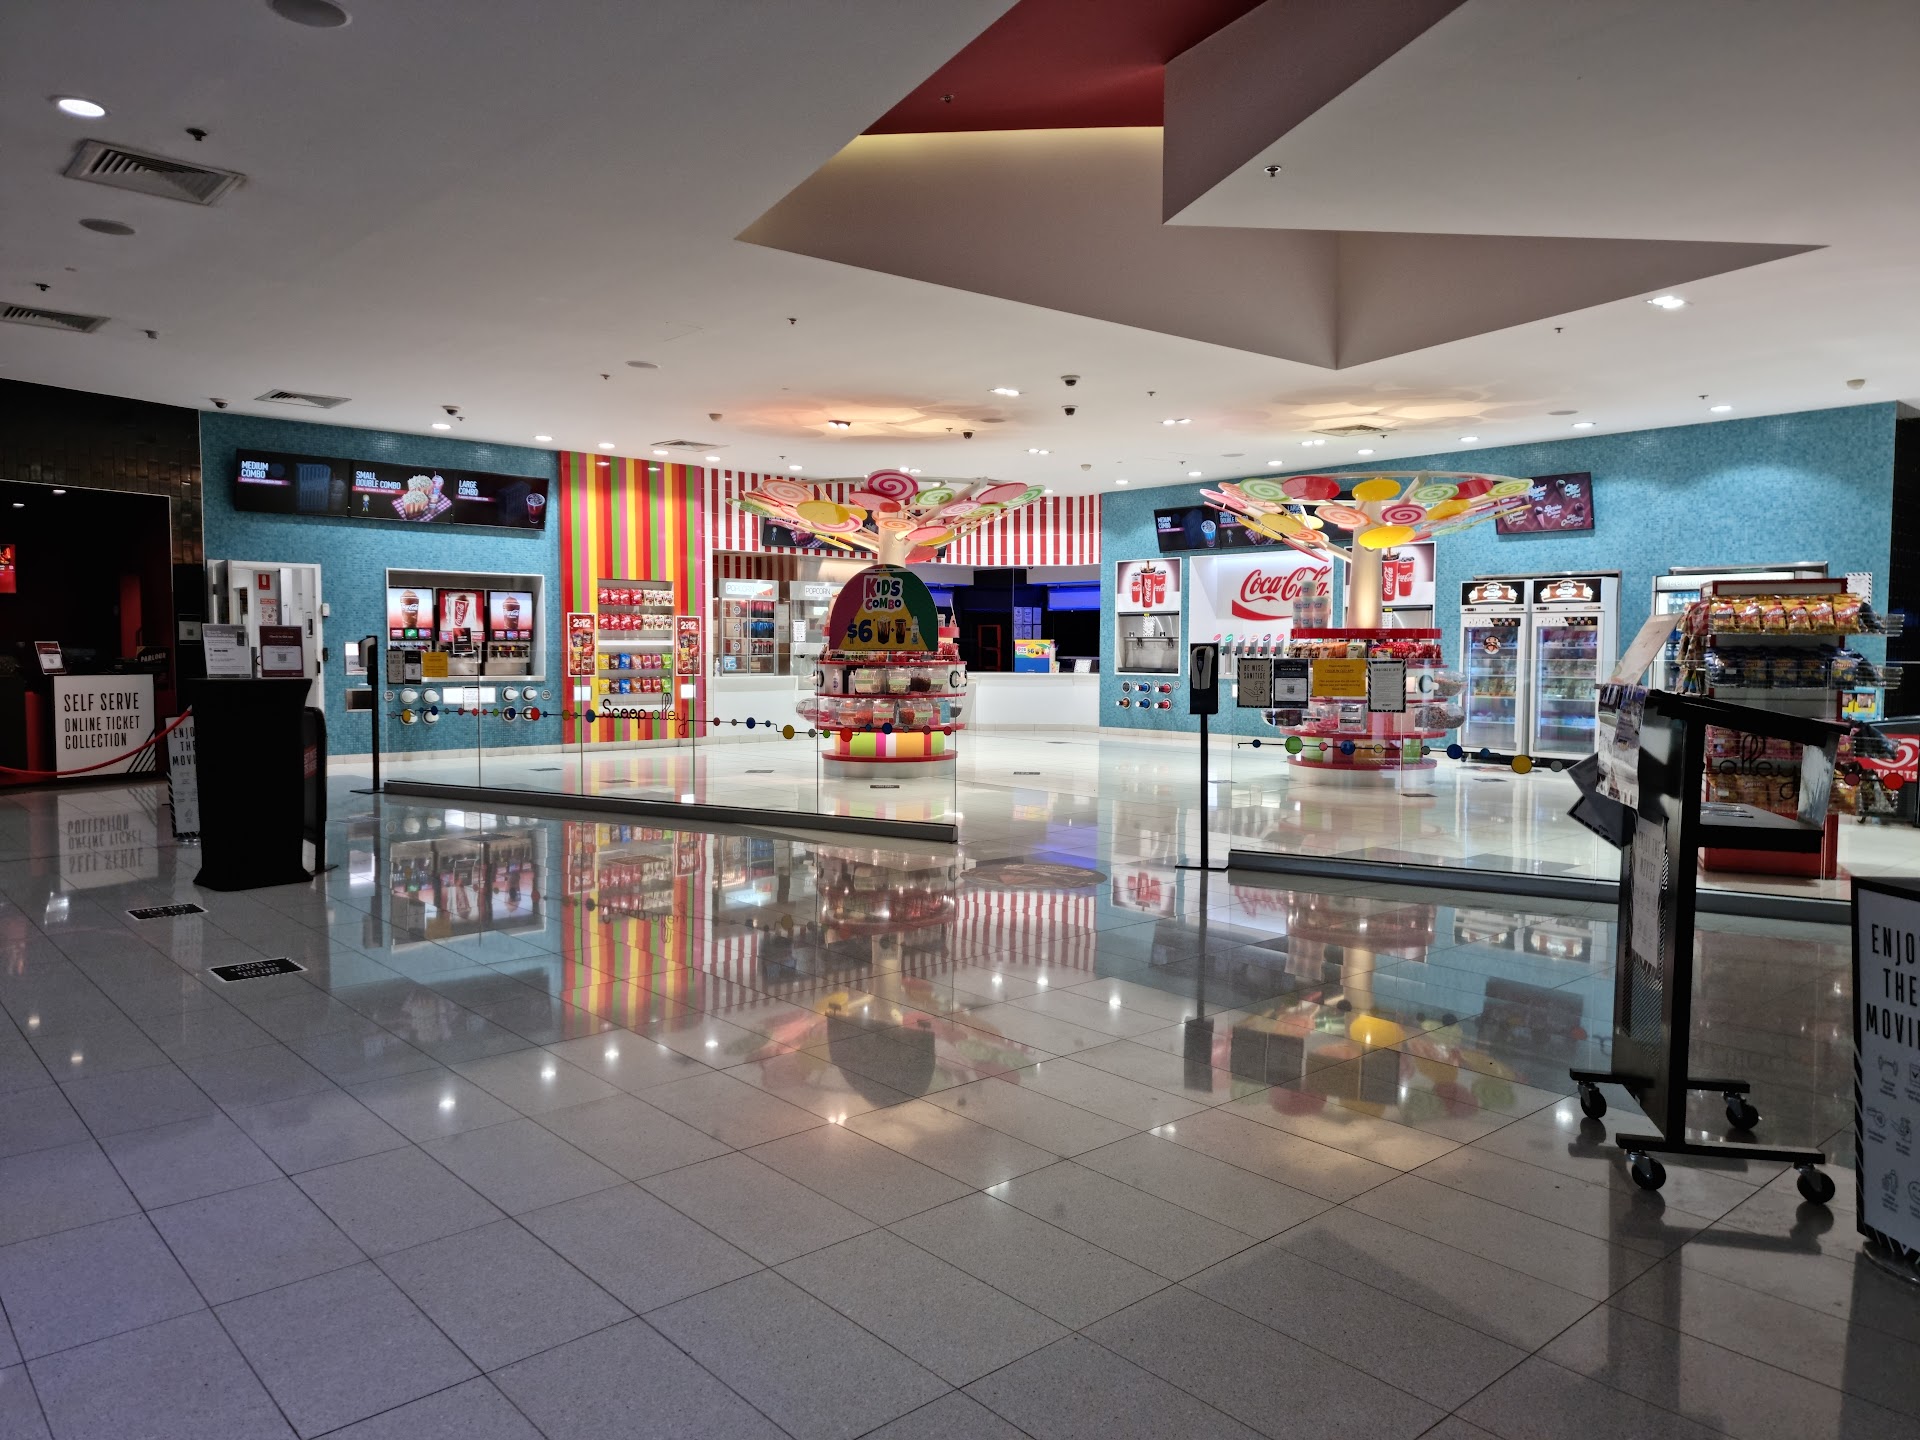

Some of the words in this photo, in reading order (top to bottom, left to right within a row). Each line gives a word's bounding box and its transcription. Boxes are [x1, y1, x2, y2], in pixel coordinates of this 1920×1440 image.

[241, 461, 269, 471] MEDIUM
[241, 469, 266, 479] COMBO
[356, 470, 377, 480] SMALL
[355, 478, 379, 488] DOUBLE
[379, 480, 402, 490] COMBO
[458, 480, 478, 489] LARGE
[458, 487, 479, 496] COMBO
[726, 584, 755, 593] POPCORN
[806, 587, 831, 595] POPCORN
[865, 578, 901, 599] KID'S
[865, 597, 902, 610] COMBO
[64, 693, 94, 713] SELF
[100, 692, 139, 711] SERVE
[65, 716, 102, 733] ONLINE
[106, 715, 140, 730] TICKET
[65, 732, 127, 750] COLLECTION
[1872, 924, 1920, 966] ENJO
[1883, 968, 1918, 1007] THE
[1866, 1003, 1920, 1048] MOVI
